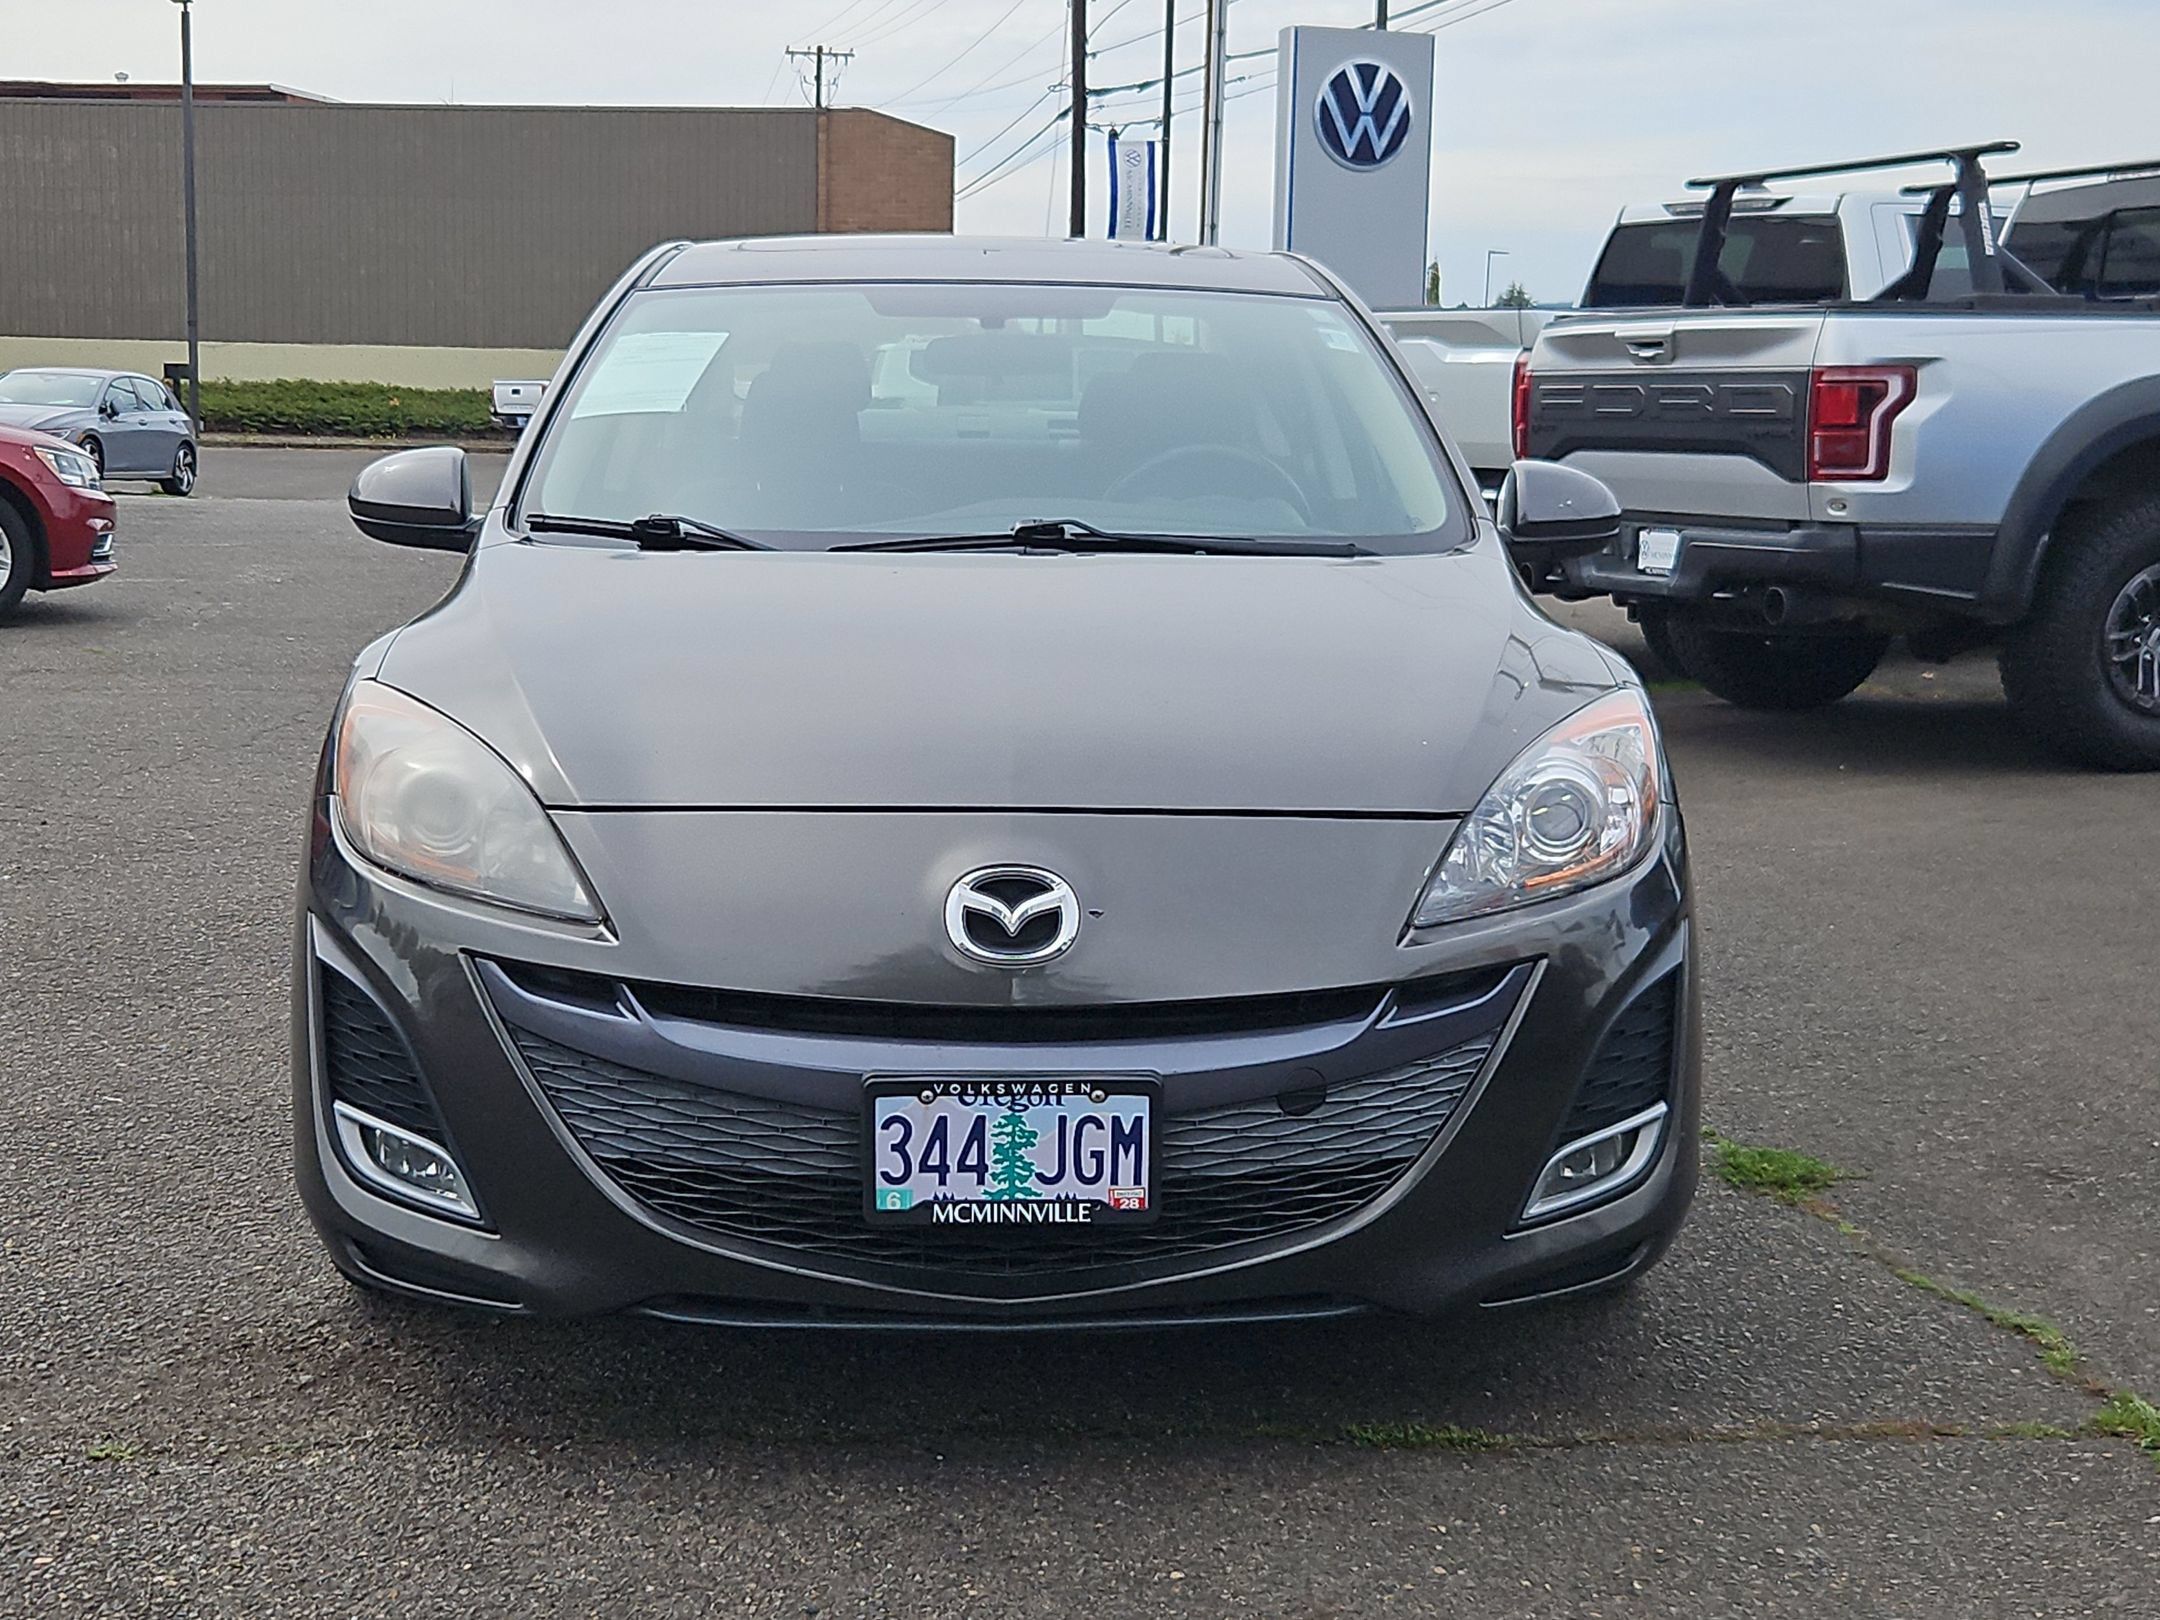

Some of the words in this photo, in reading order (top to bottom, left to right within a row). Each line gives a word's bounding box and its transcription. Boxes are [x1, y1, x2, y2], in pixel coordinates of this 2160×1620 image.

[1317, 60, 1411, 166] VW
[1538, 383, 1796, 420] FORD
[933, 1083, 1091, 1095] VOLKSWAGEN
[880, 1114, 989, 1187] 344
[1036, 1114, 1144, 1187] JGM
[886, 1192, 901, 1210] 6
[1119, 1198, 1140, 1209] 28
[932, 1202, 1092, 1224] MCMINNVILLE
